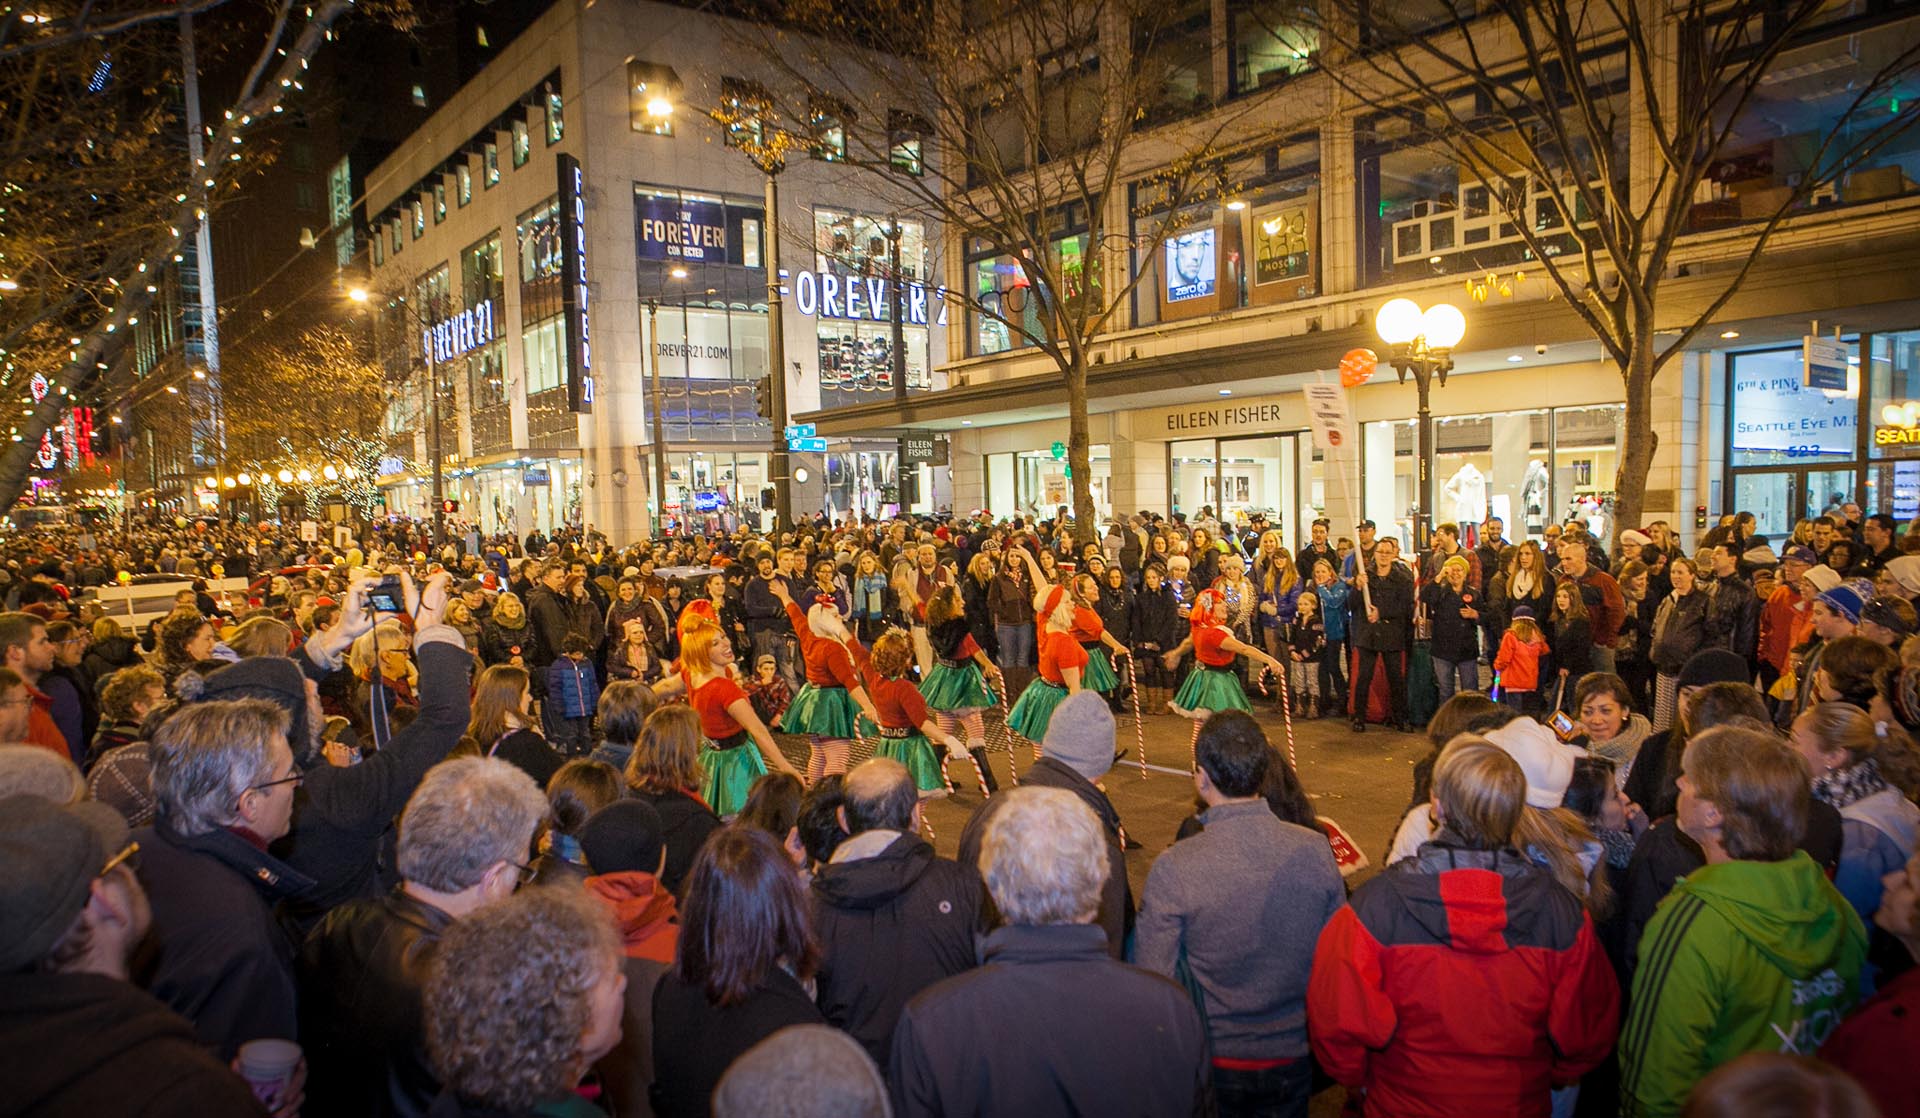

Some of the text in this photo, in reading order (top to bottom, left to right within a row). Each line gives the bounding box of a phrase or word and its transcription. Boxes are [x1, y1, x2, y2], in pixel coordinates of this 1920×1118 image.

[574, 166, 595, 403] FOREVER 21
[778, 268, 928, 326] FOREVR
[475, 299, 493, 345] 21
[650, 343, 729, 360] OREVER21.COM
[1759, 380, 1768, 391] &
[1167, 404, 1281, 430] EILEEN FISHER
[907, 440, 933, 449] EILEEN
[908, 448, 933, 457] FISHER
[1787, 444, 1821, 457] 523
